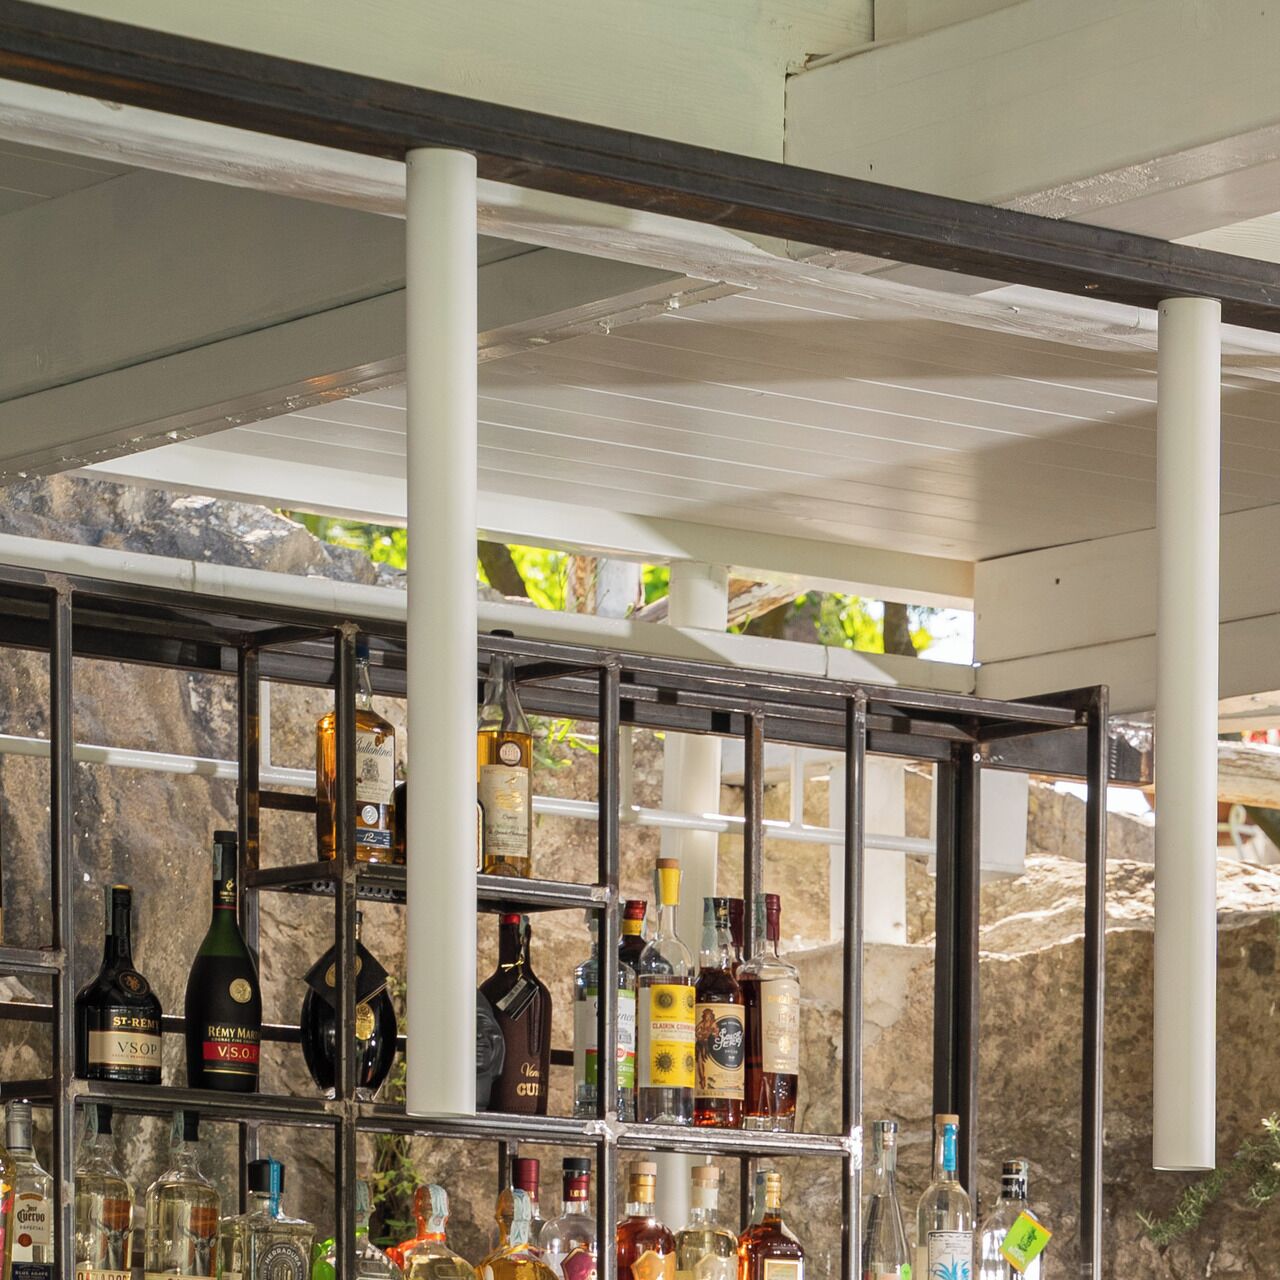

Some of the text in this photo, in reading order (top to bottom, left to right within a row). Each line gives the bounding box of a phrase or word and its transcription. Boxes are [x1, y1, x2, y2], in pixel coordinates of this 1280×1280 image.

[363, 832, 377, 843] 12
[208, 1025, 235, 1038] RÉMY
[117, 1041, 157, 1055] VSOP
[17, 1209, 45, 1223] Cuervo
[265, 1247, 301, 1267] HERRADURA
